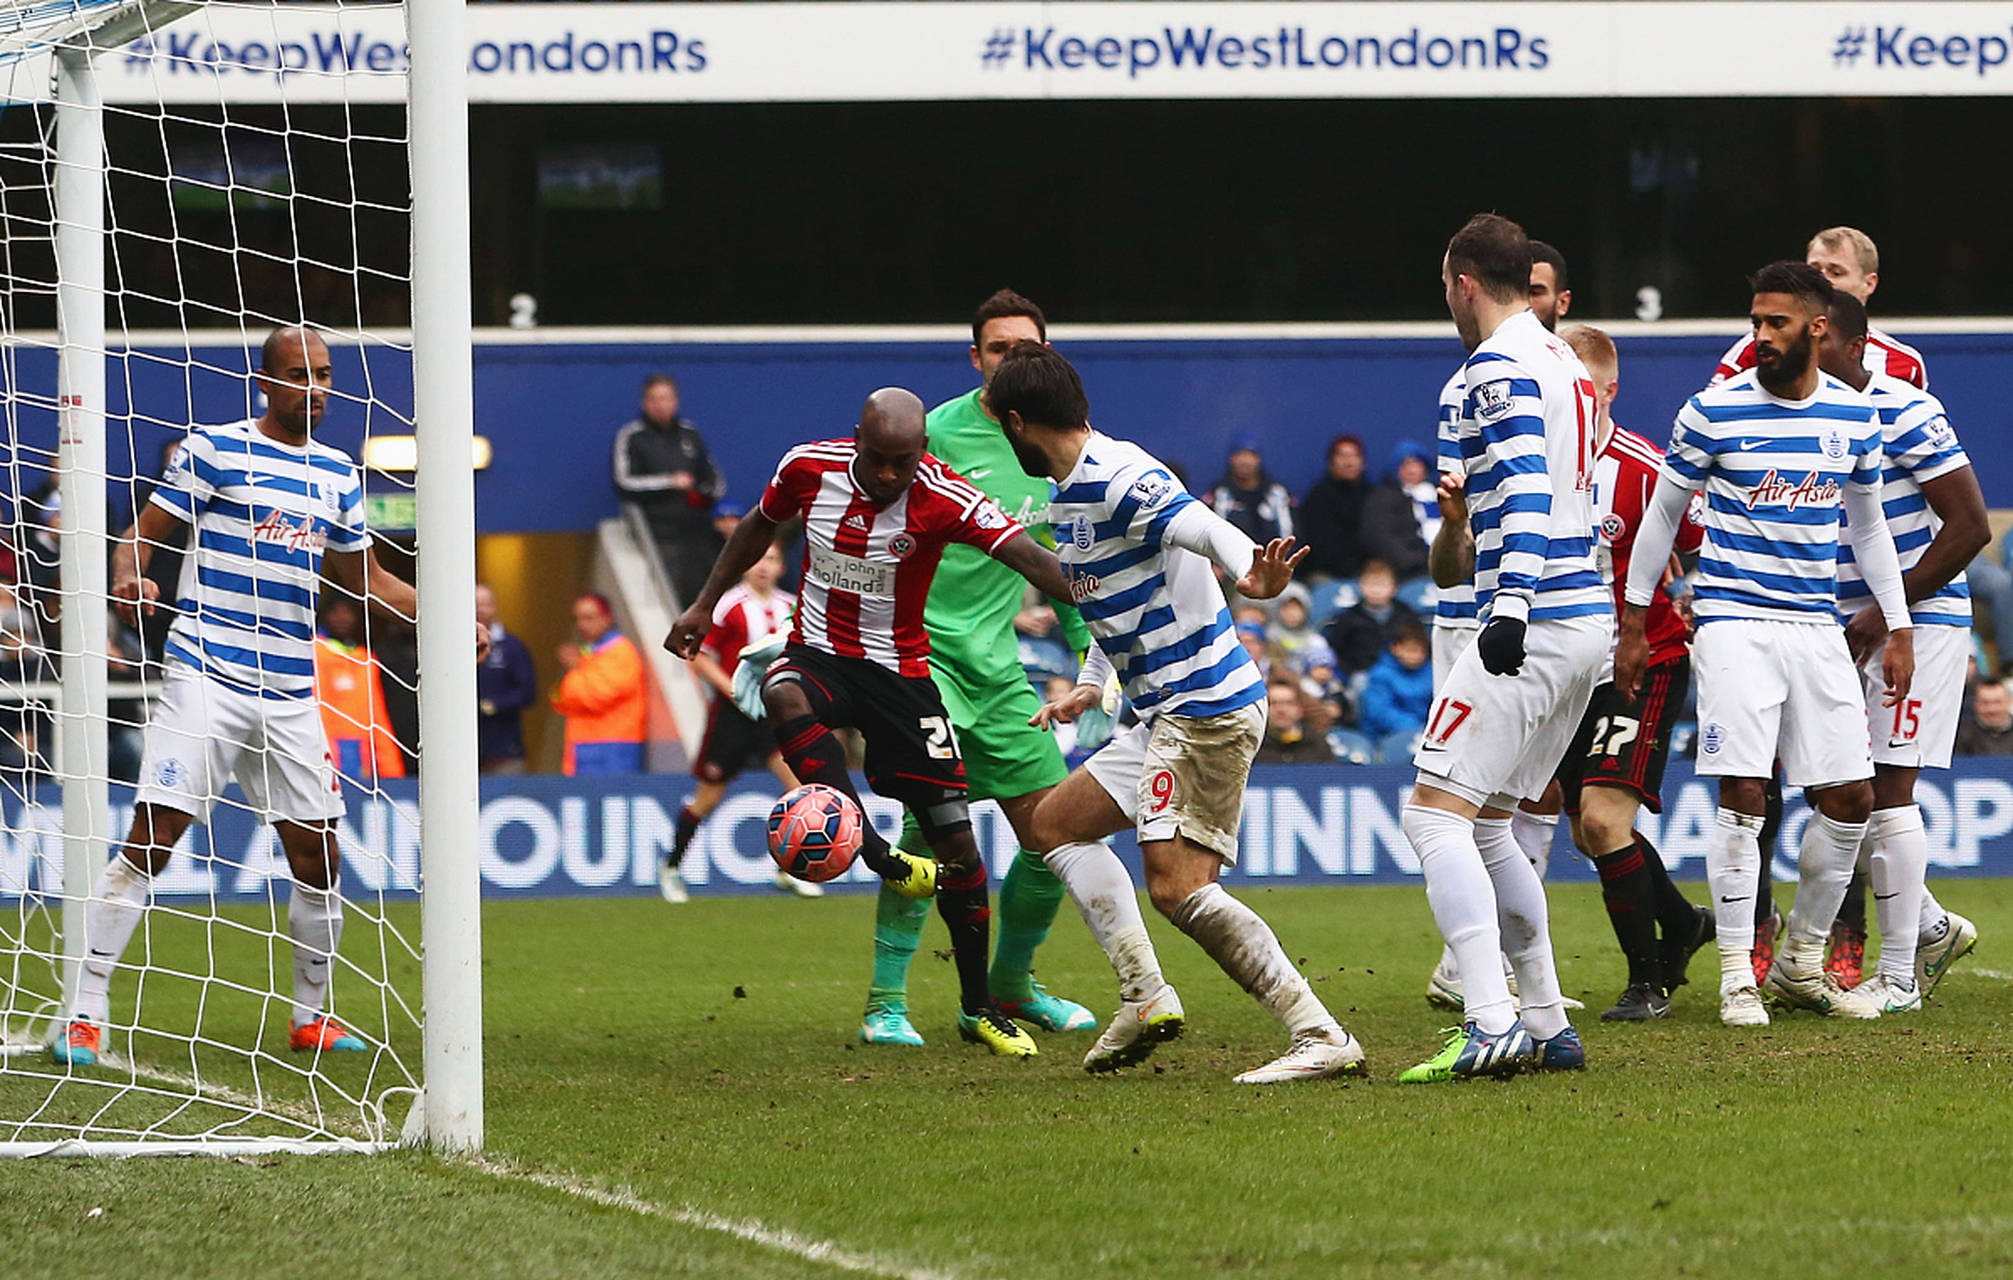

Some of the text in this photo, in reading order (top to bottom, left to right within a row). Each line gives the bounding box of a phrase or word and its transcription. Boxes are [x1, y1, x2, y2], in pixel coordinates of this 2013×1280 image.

[980, 27, 1550, 78] #KeepWestLondonRs
[1833, 25, 2013, 77] #Keep
[509, 293, 537, 329] 2
[1635, 286, 1663, 322] 3
[1425, 696, 1472, 744] 17
[1586, 715, 1640, 757] 27
[1891, 699, 1922, 739] 15
[1151, 771, 1173, 813] 9
